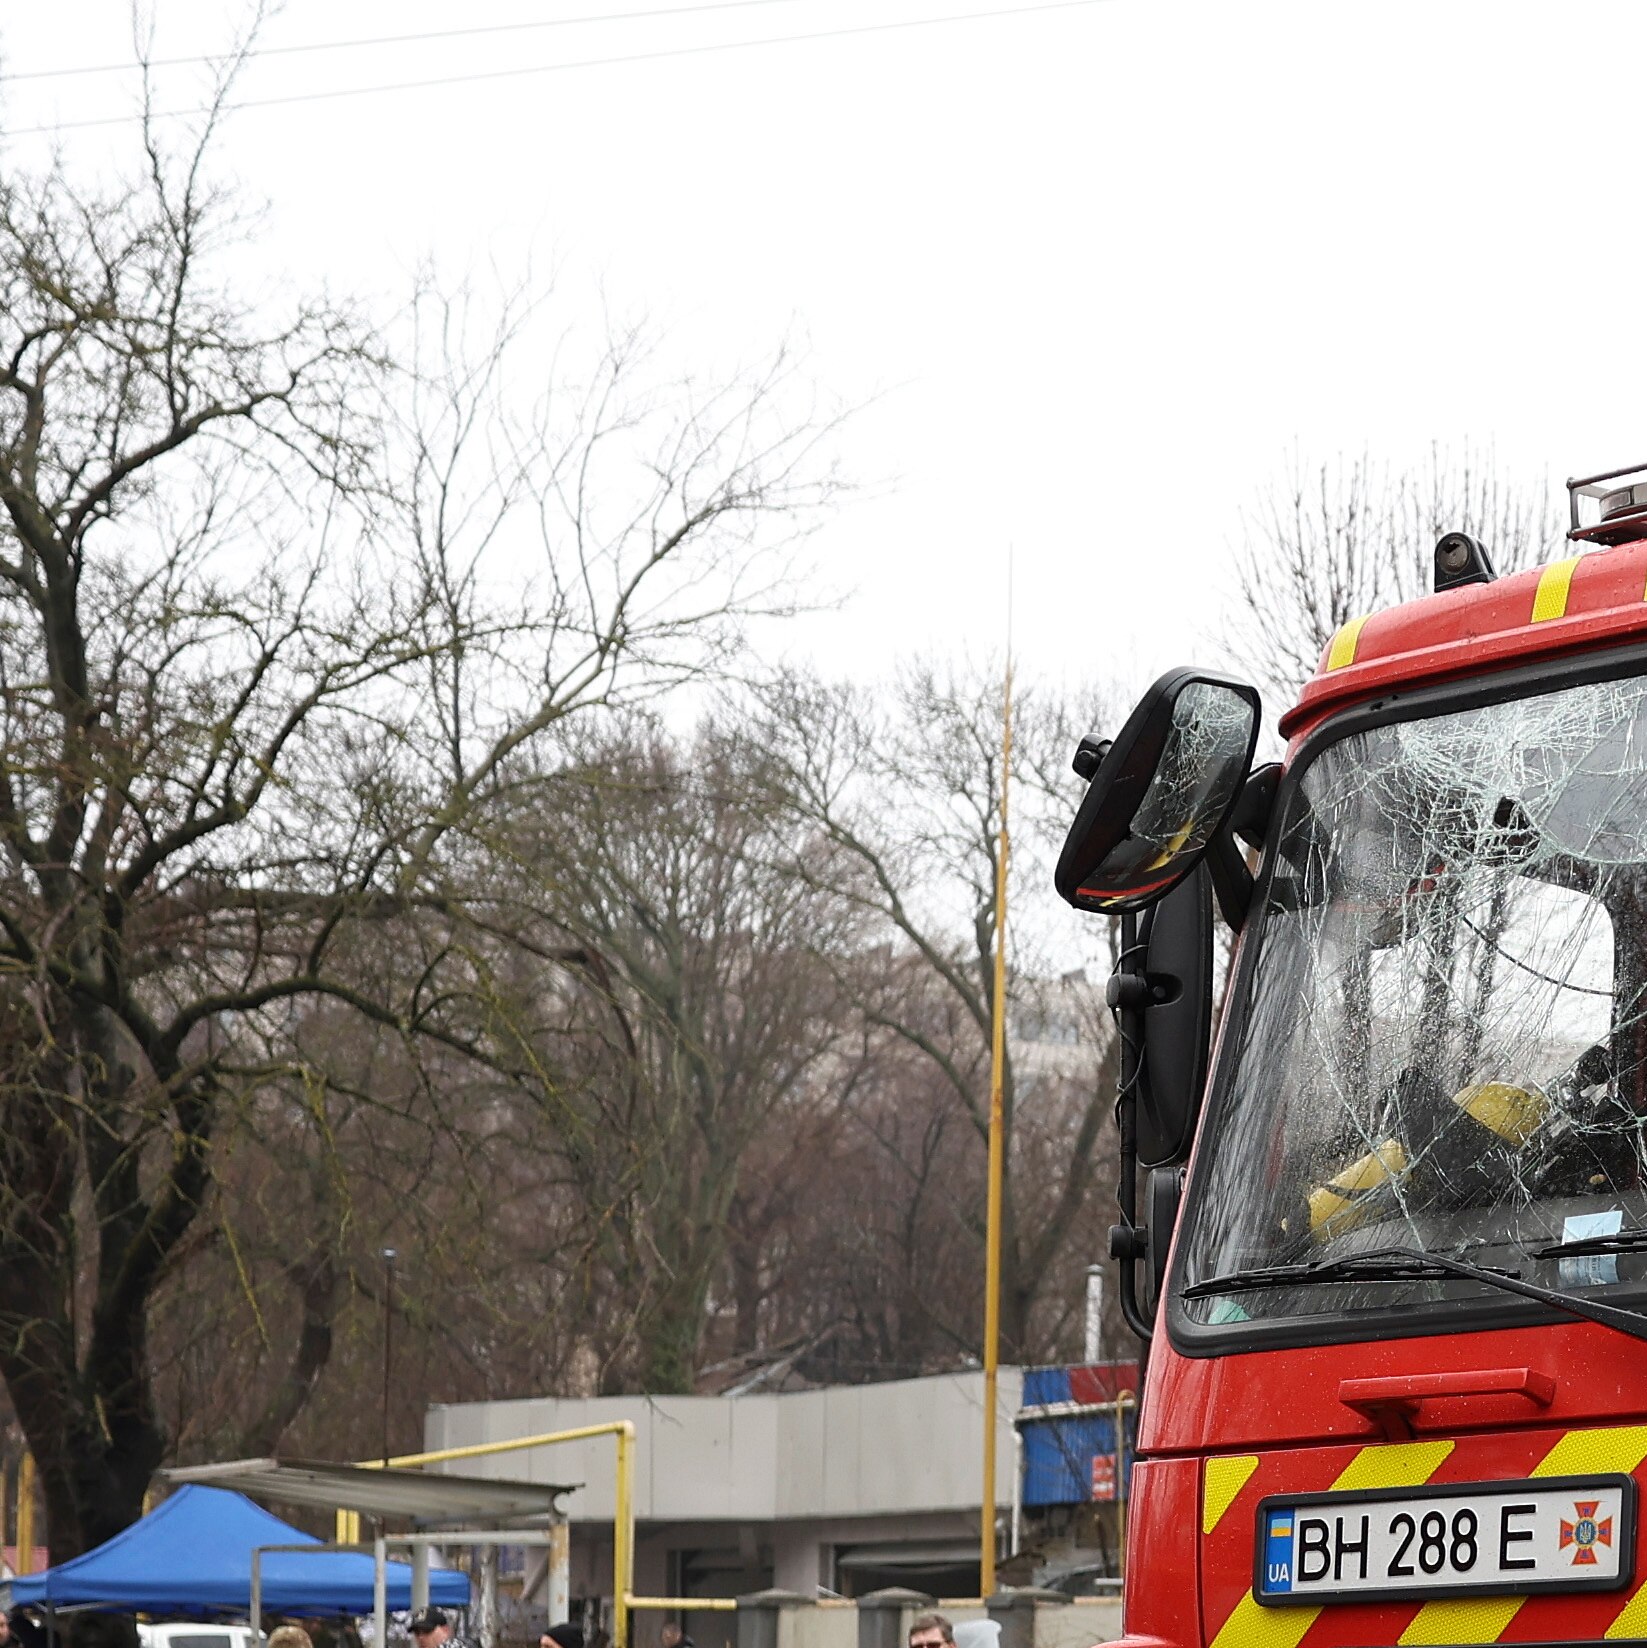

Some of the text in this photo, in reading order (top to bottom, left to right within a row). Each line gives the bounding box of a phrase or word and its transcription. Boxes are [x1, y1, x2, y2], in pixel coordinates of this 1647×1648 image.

[1297, 1503, 1537, 1583] BH 288 E
[1268, 1562, 1290, 1583] UA
